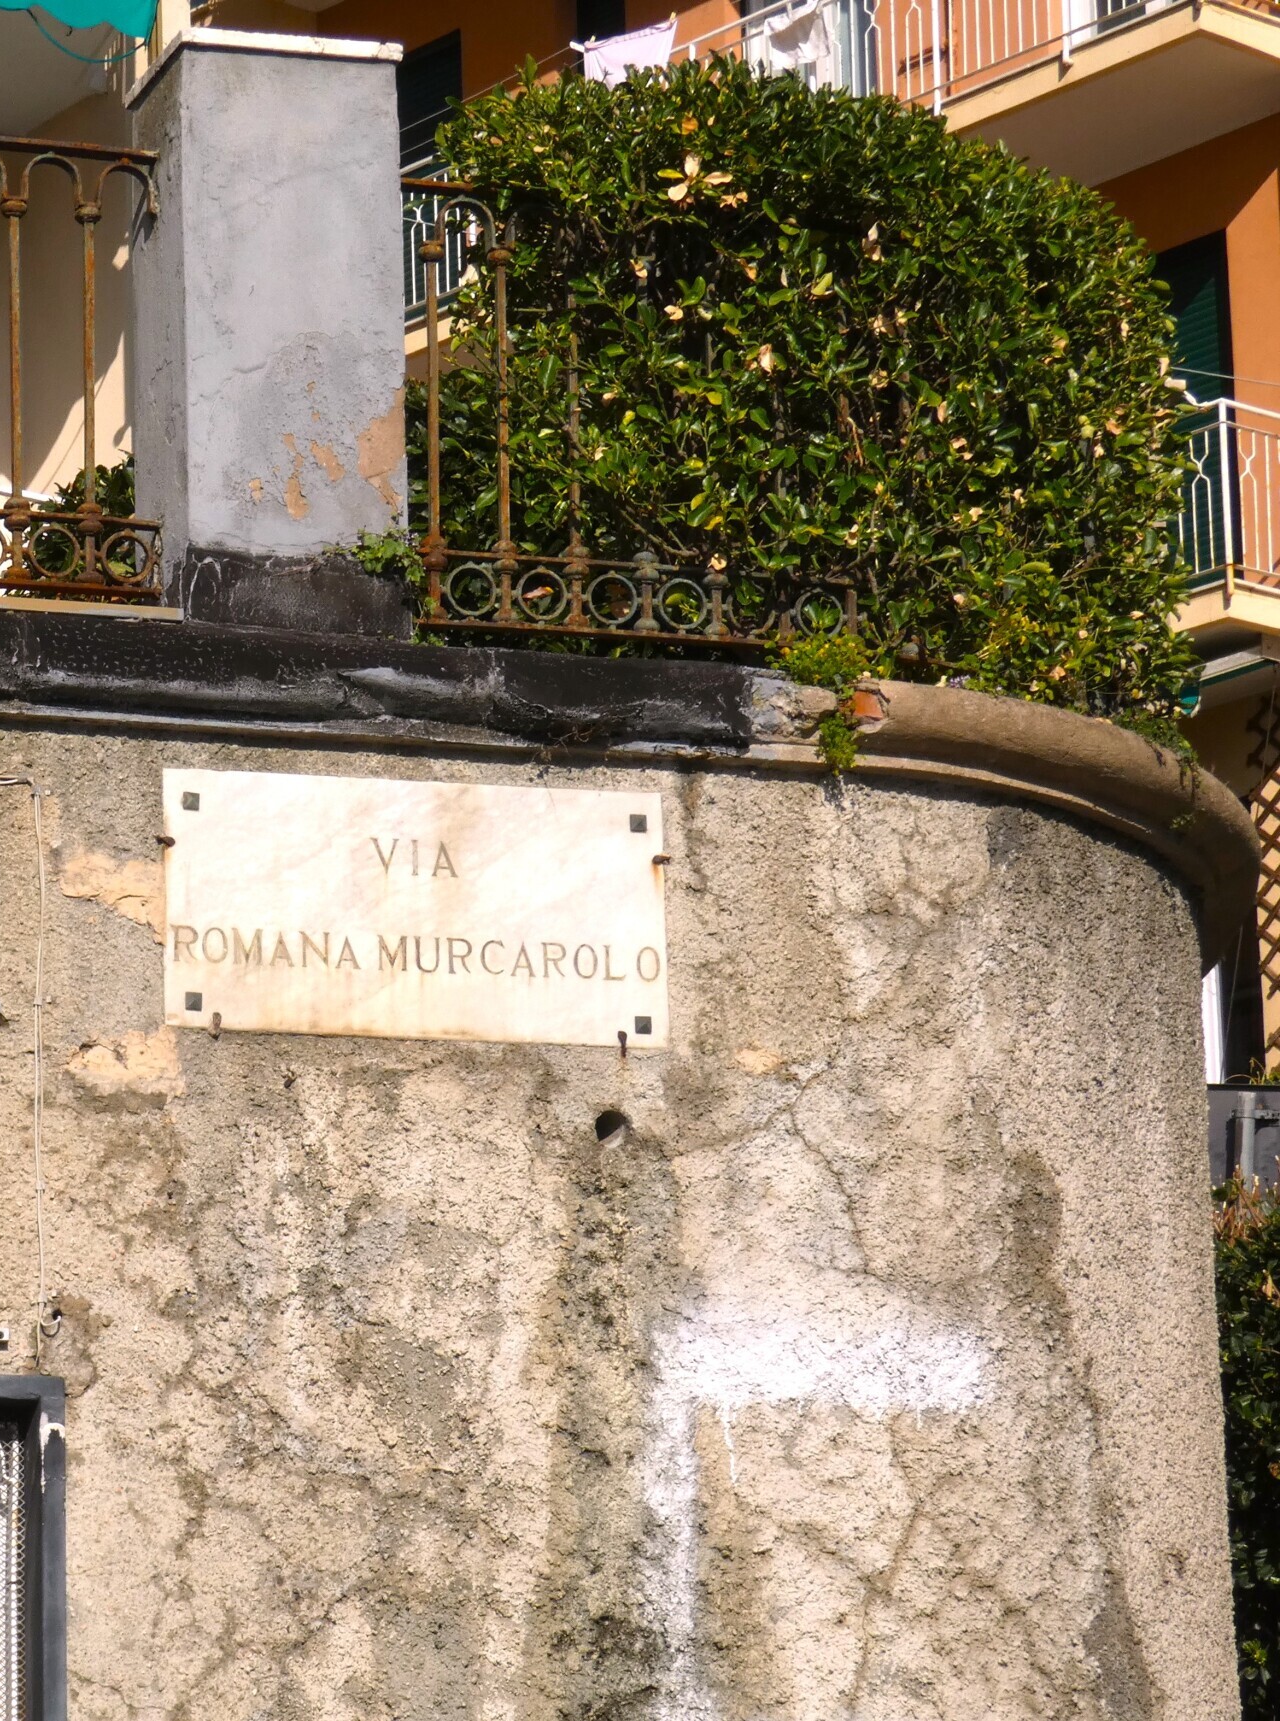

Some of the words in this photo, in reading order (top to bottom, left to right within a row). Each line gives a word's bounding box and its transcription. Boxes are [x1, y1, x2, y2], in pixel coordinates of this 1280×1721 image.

[369, 836, 458, 878] VIA
[170, 924, 360, 970] ROMANA
[377, 935, 661, 983] MURCAROLO
